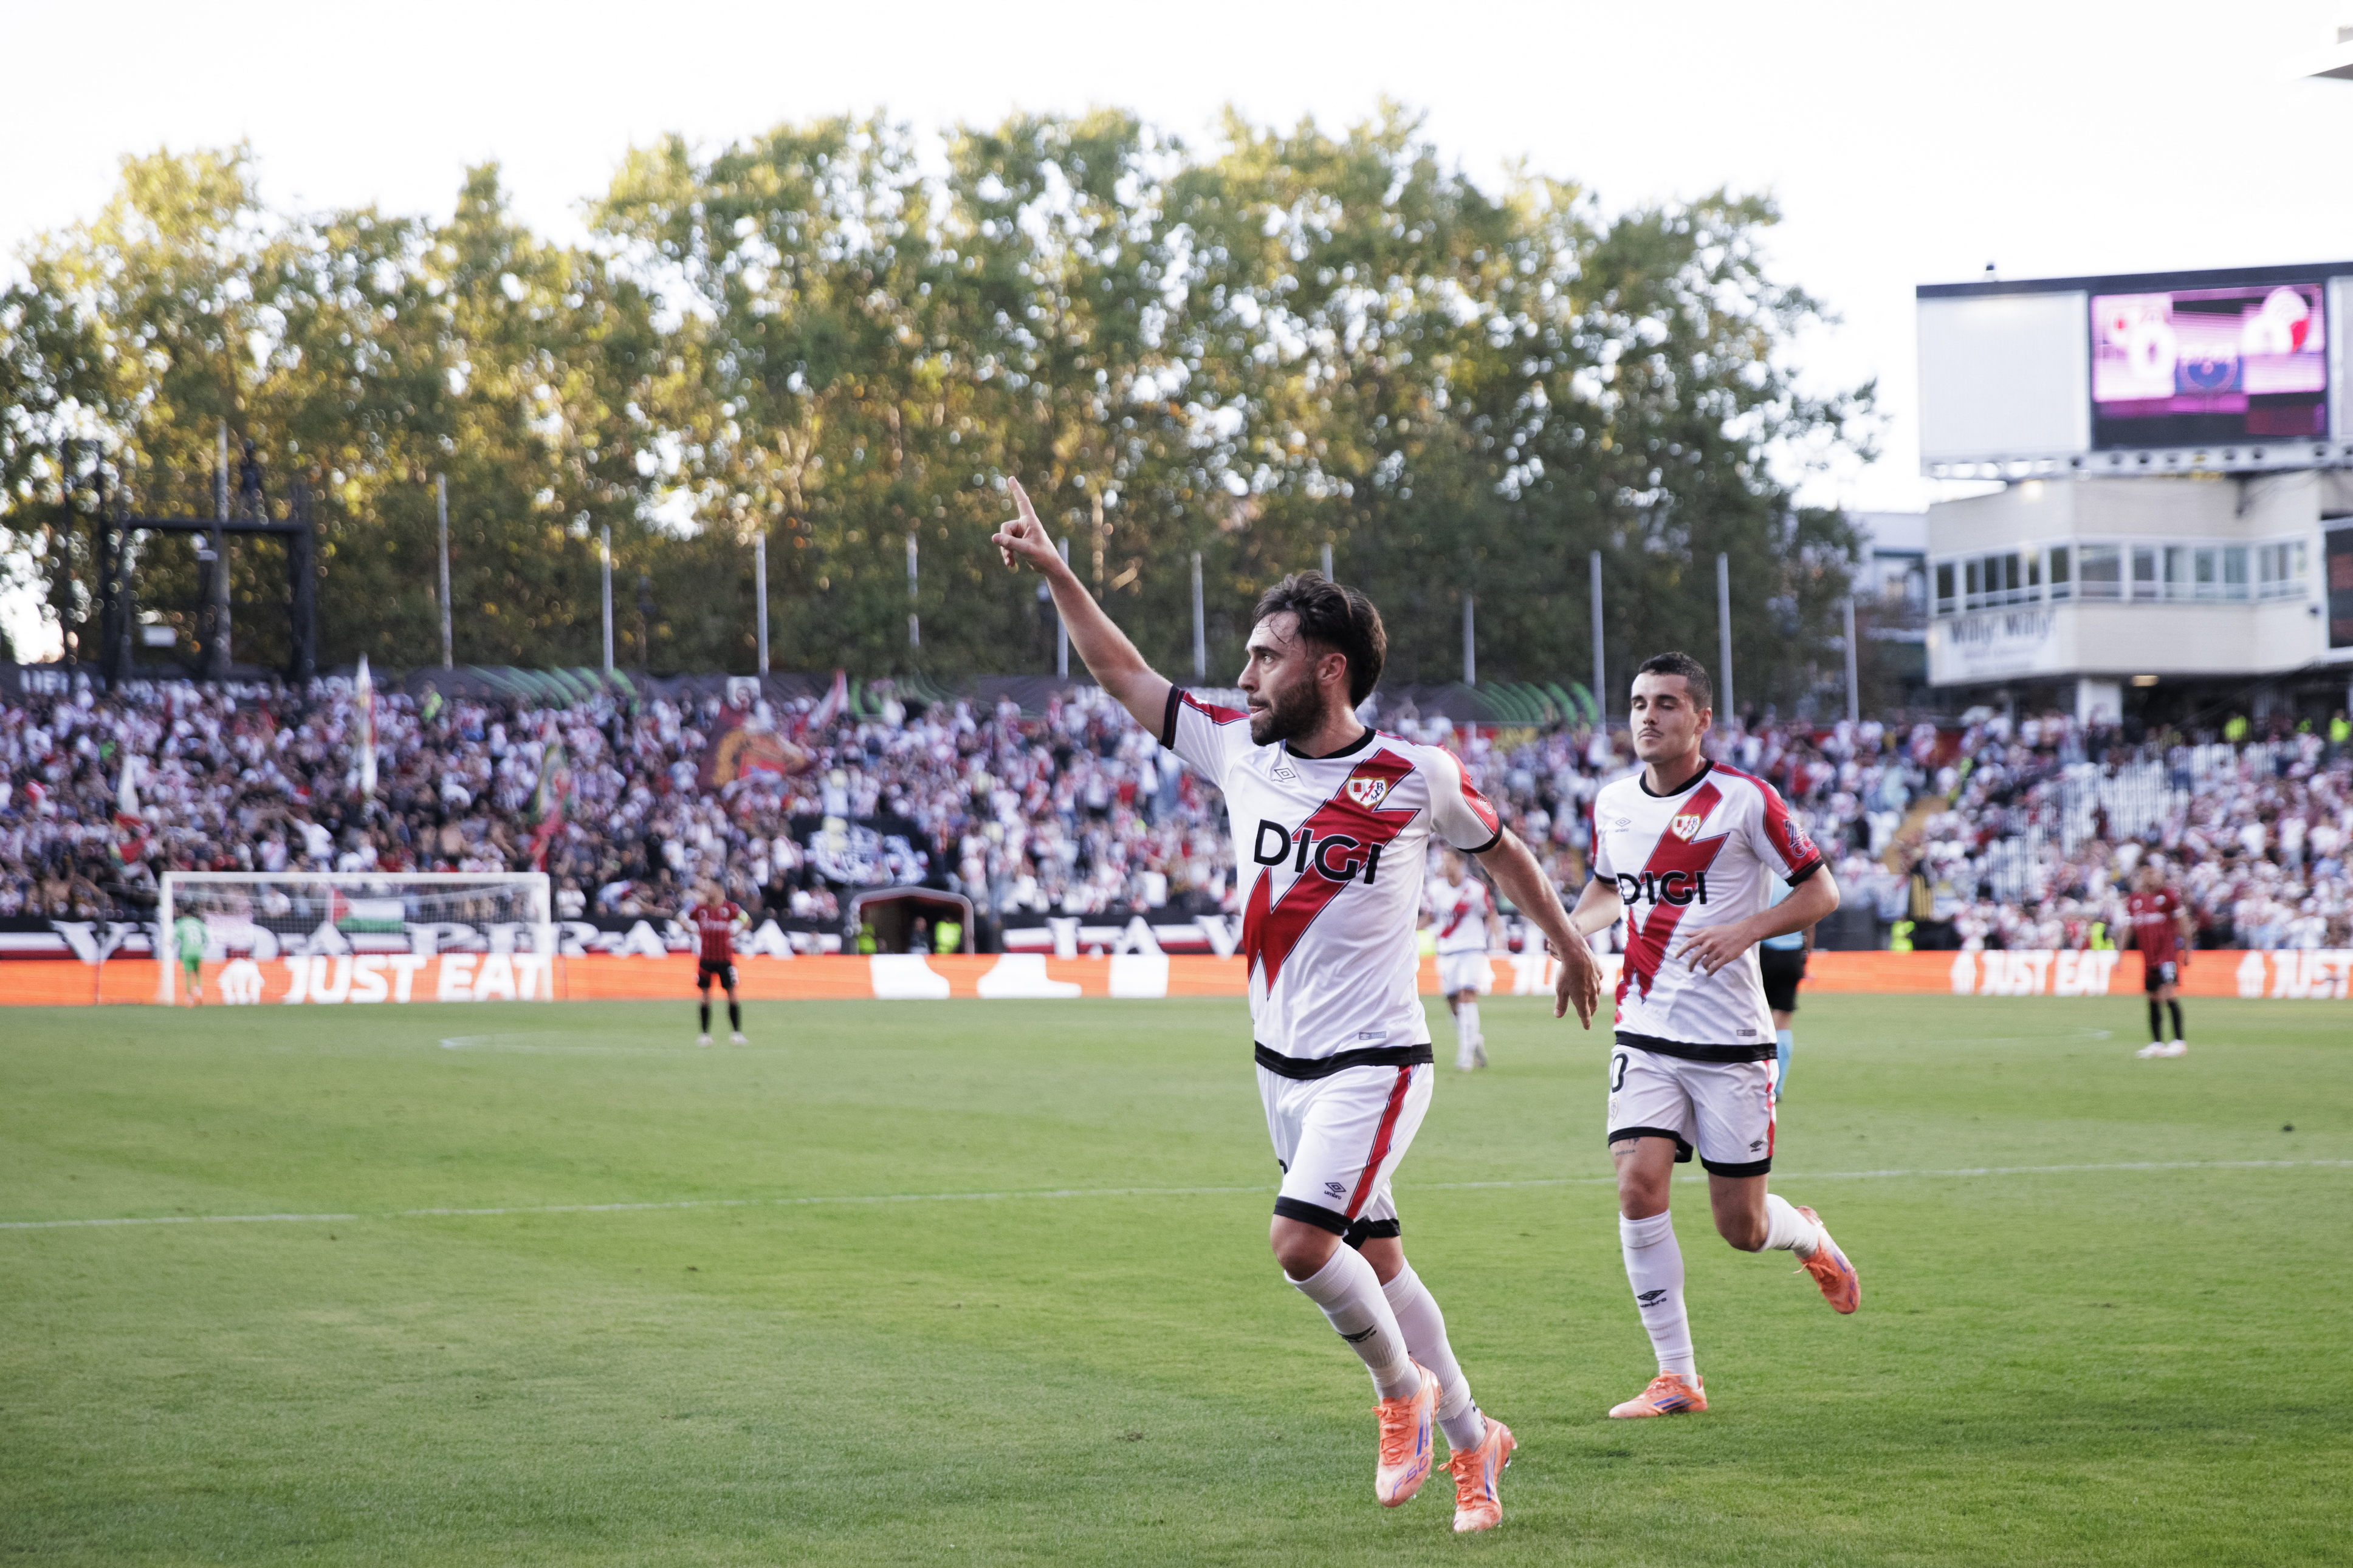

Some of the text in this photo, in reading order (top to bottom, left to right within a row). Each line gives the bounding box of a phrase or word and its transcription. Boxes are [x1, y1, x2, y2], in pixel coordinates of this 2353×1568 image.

[1254, 819, 1383, 885] DIGI
[1616, 871, 1708, 905] DIGI
[283, 953, 548, 1004] JUST EAT
[1980, 949, 2054, 996] JUST
[2053, 949, 2120, 997] EAT
[1324, 1190, 1341, 1200] umbro
[1640, 1297, 1667, 1308] umbro
[1392, 1452, 1429, 1497] F50
